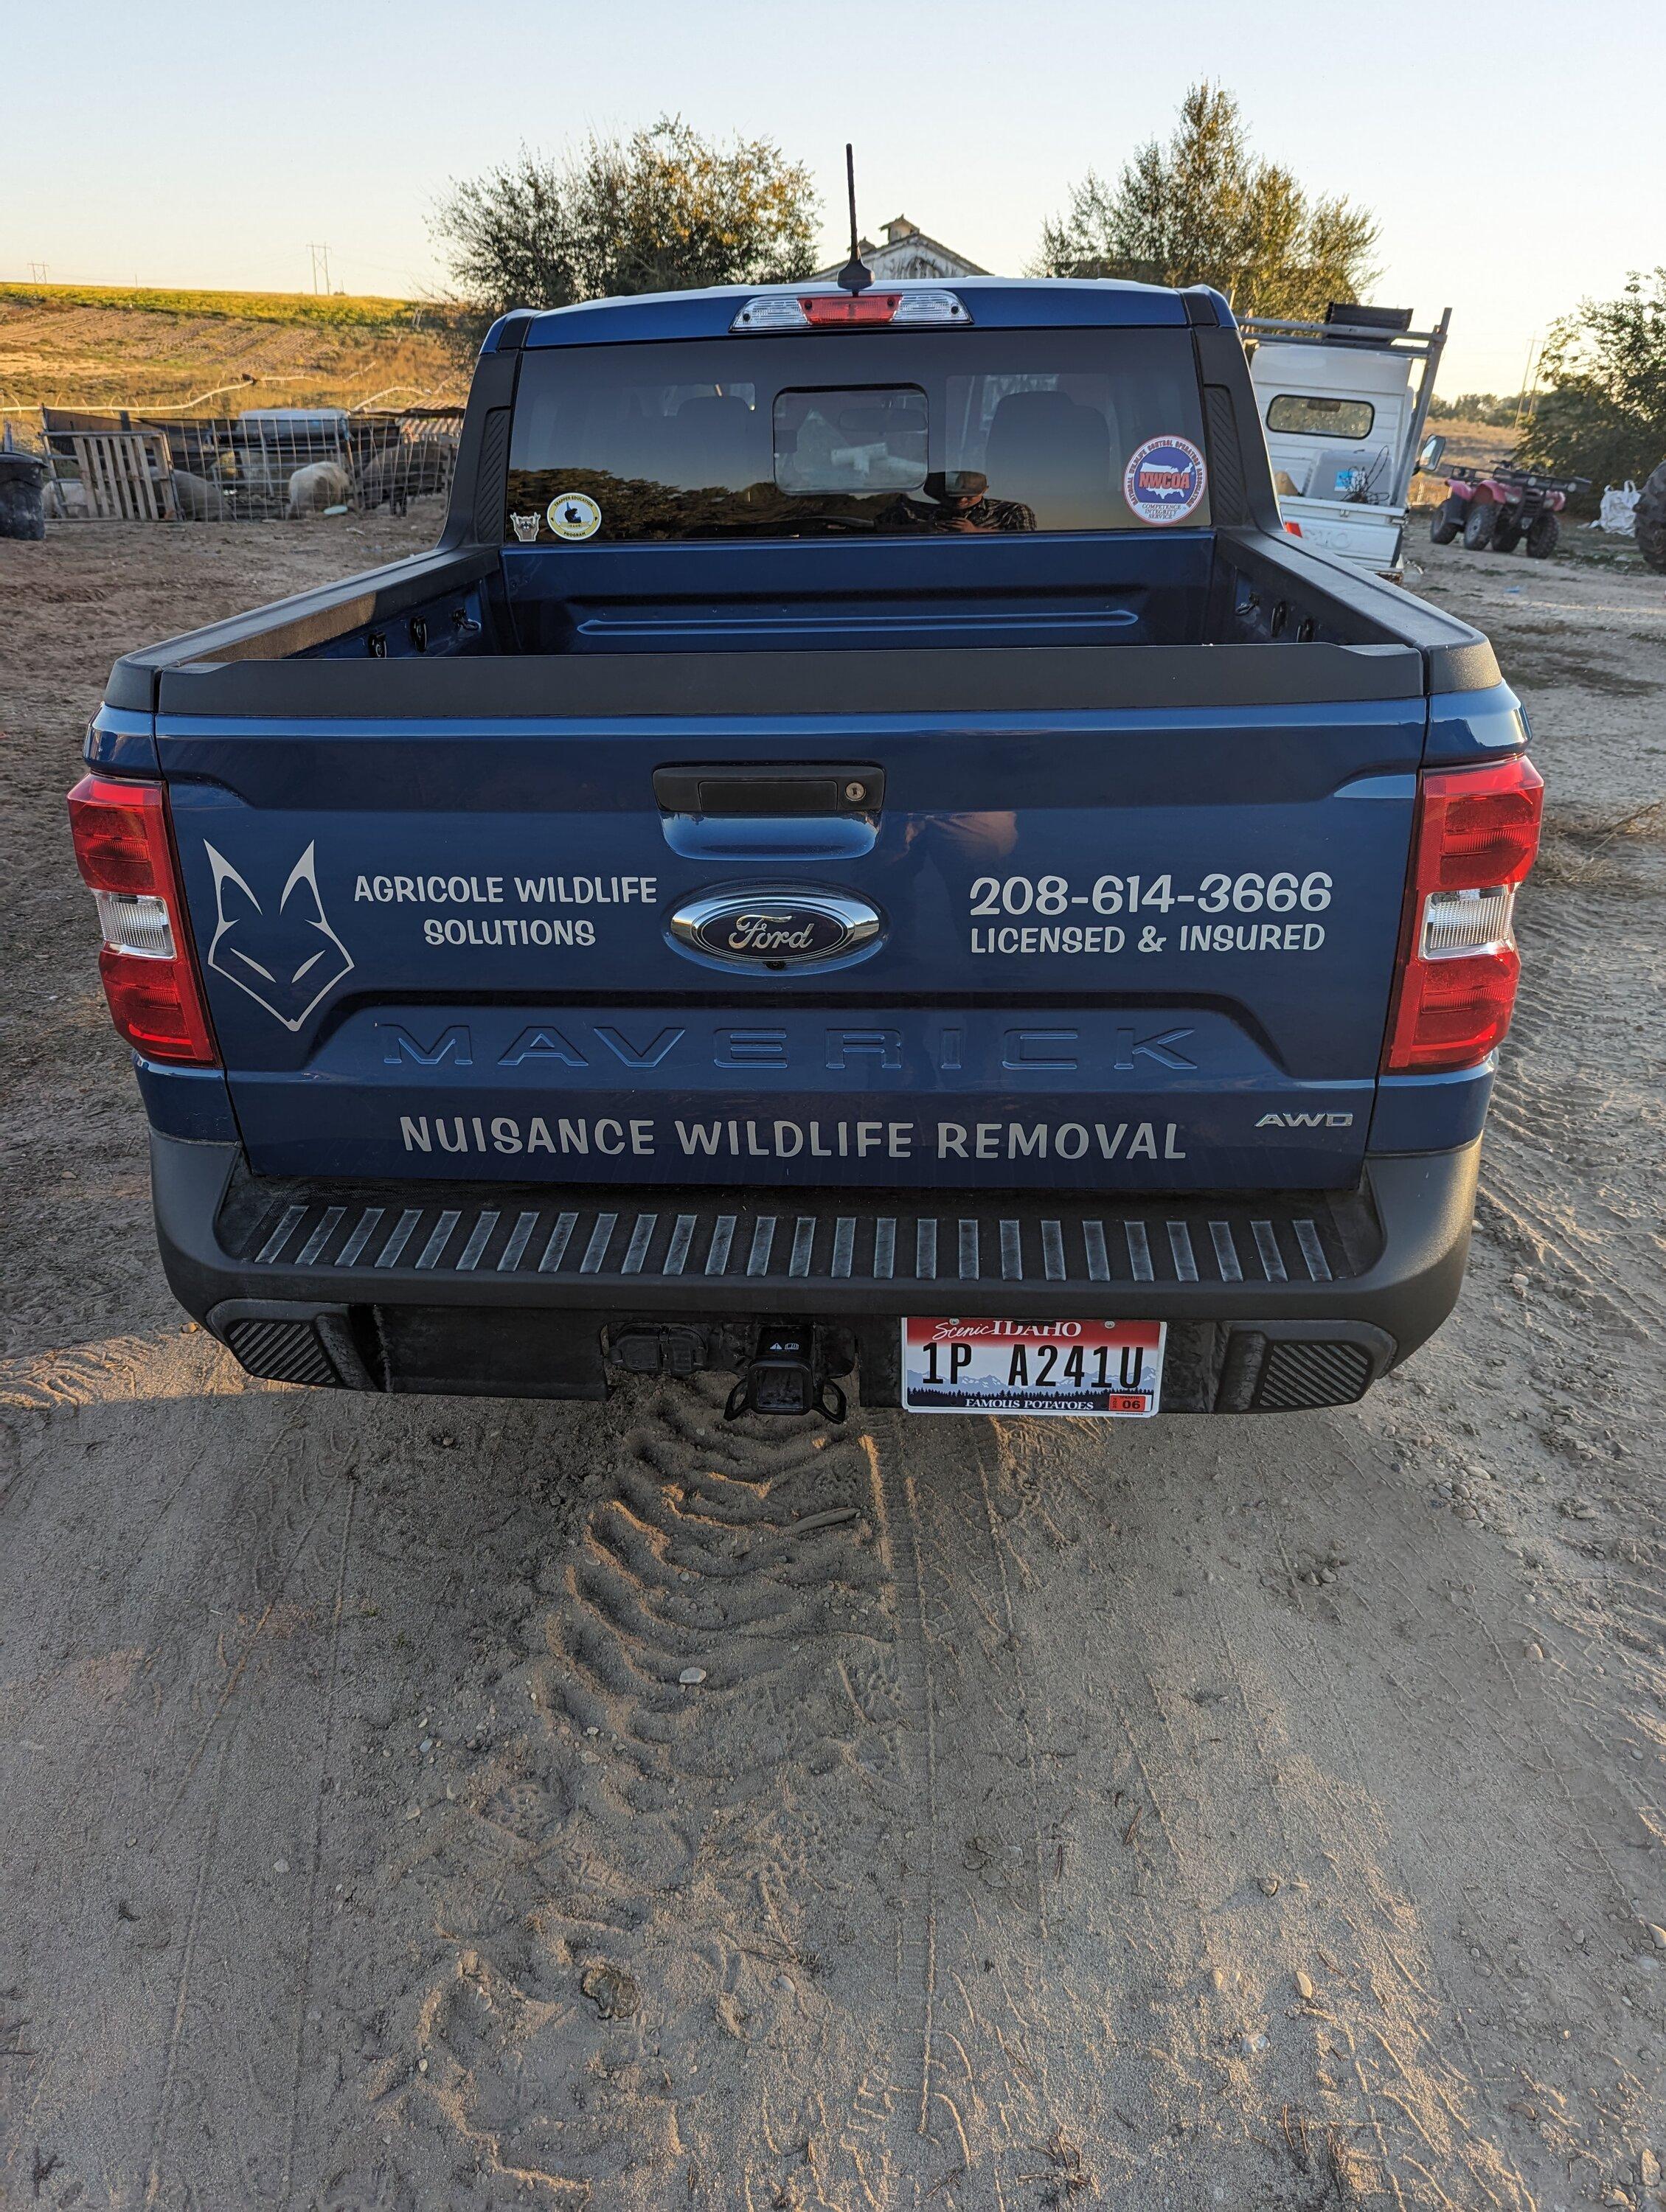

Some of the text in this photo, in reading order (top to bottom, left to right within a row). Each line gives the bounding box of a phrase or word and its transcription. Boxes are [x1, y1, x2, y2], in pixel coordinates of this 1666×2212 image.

[1148, 439, 1173, 451] CONTROL
[1176, 441, 1201, 467] OPERATORS
[1139, 471, 1190, 489] NWCOA
[554, 495, 594, 507] TRAPPER EDUCATION
[354, 875, 657, 904] AGRICOLE WILDLIFE
[969, 872, 1333, 916] 208-614-3666
[423, 919, 597, 946] SOLUTIONS
[728, 914, 815, 949] Ford
[971, 923, 1325, 953] LICENSED & INSURED
[380, 1024, 1198, 1069] MAVERICK
[1254, 1112, 1353, 1127] AWD
[400, 1116, 1186, 1160] NUISANCE WILDLIFE REMOVAL
[932, 1320, 1081, 1340] Scenic IDAHO
[922, 1342, 1144, 1388] 1P A241U
[965, 1398, 1094, 1411] FAMOUS POTATOES
[1122, 1399, 1141, 1409] 06
